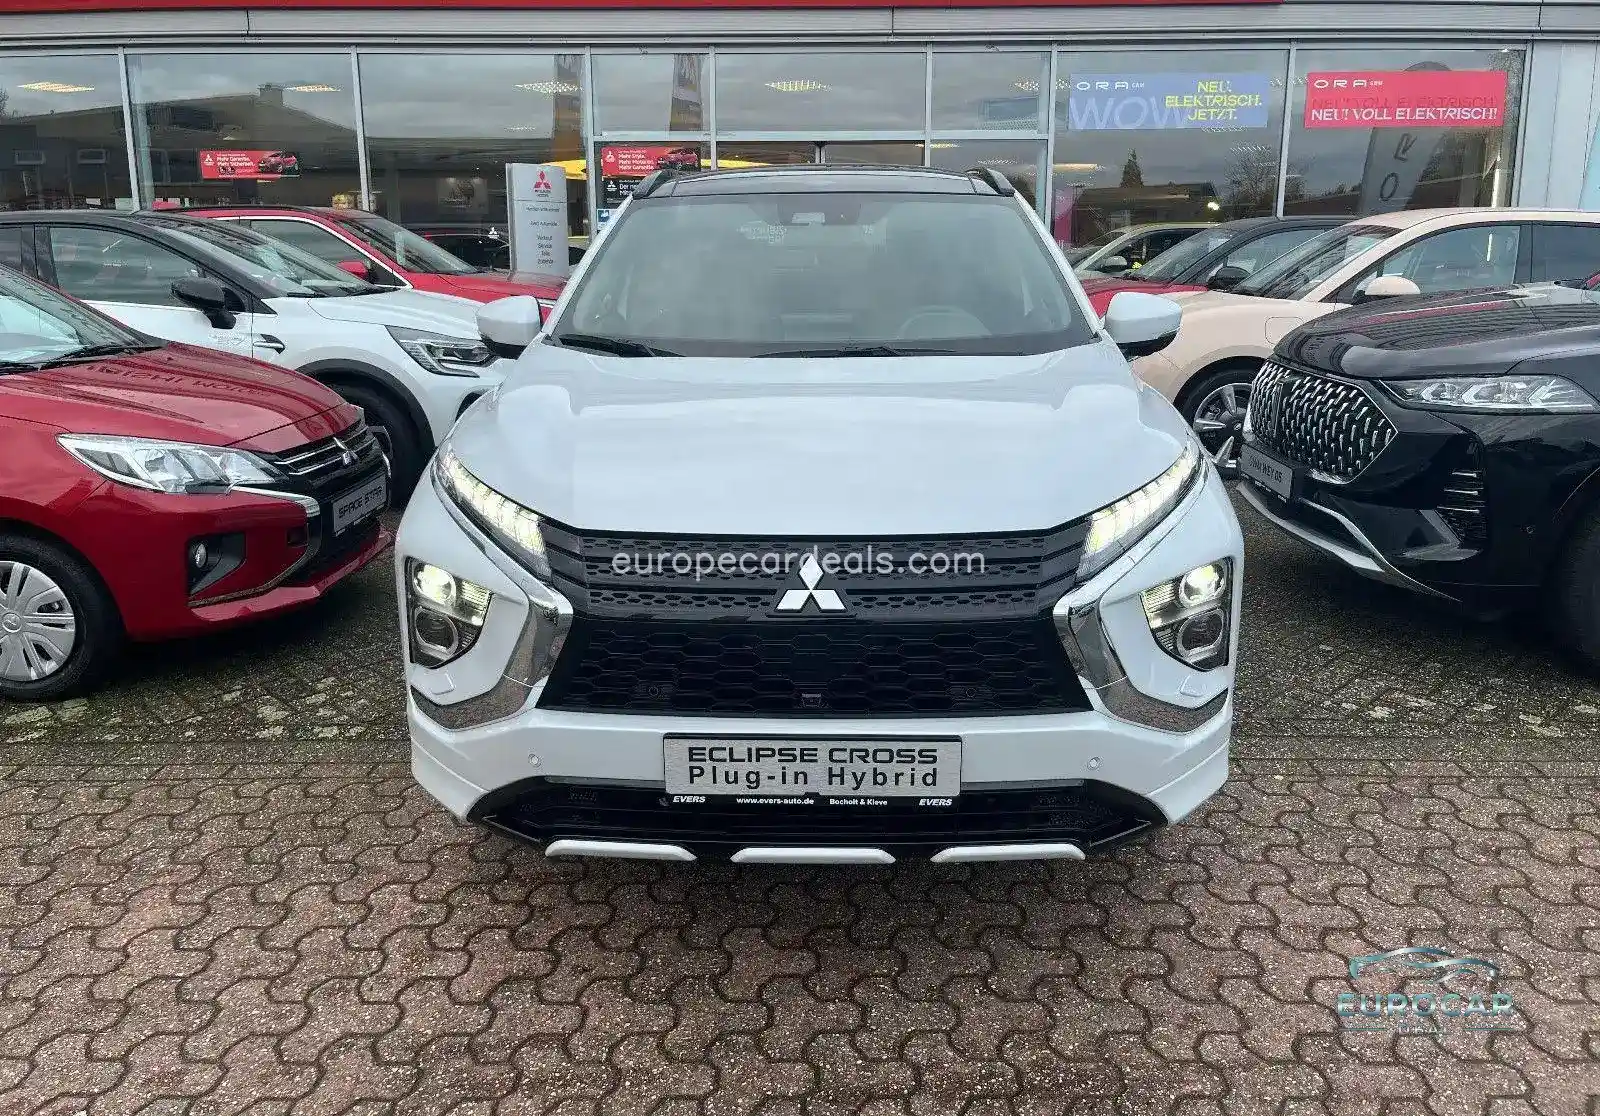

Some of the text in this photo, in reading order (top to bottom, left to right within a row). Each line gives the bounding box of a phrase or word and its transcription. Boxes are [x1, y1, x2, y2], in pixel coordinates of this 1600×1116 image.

[1076, 82, 1129, 91] ORA
[1314, 79, 1367, 88] ORA
[1165, 95, 1263, 108] ELEKTRISCH.
[1188, 108, 1238, 121] JETZT.
[1311, 107, 1498, 121] NEU! VOLL ELEKTRISCH!
[688, 746, 938, 764] ECLIPSE CROSS
[688, 765, 937, 791] Plug-in Hybrid
[672, 795, 707, 803] EVERS
[735, 796, 815, 805] www.evers-auto.de
[918, 798, 953, 806] EVERS
